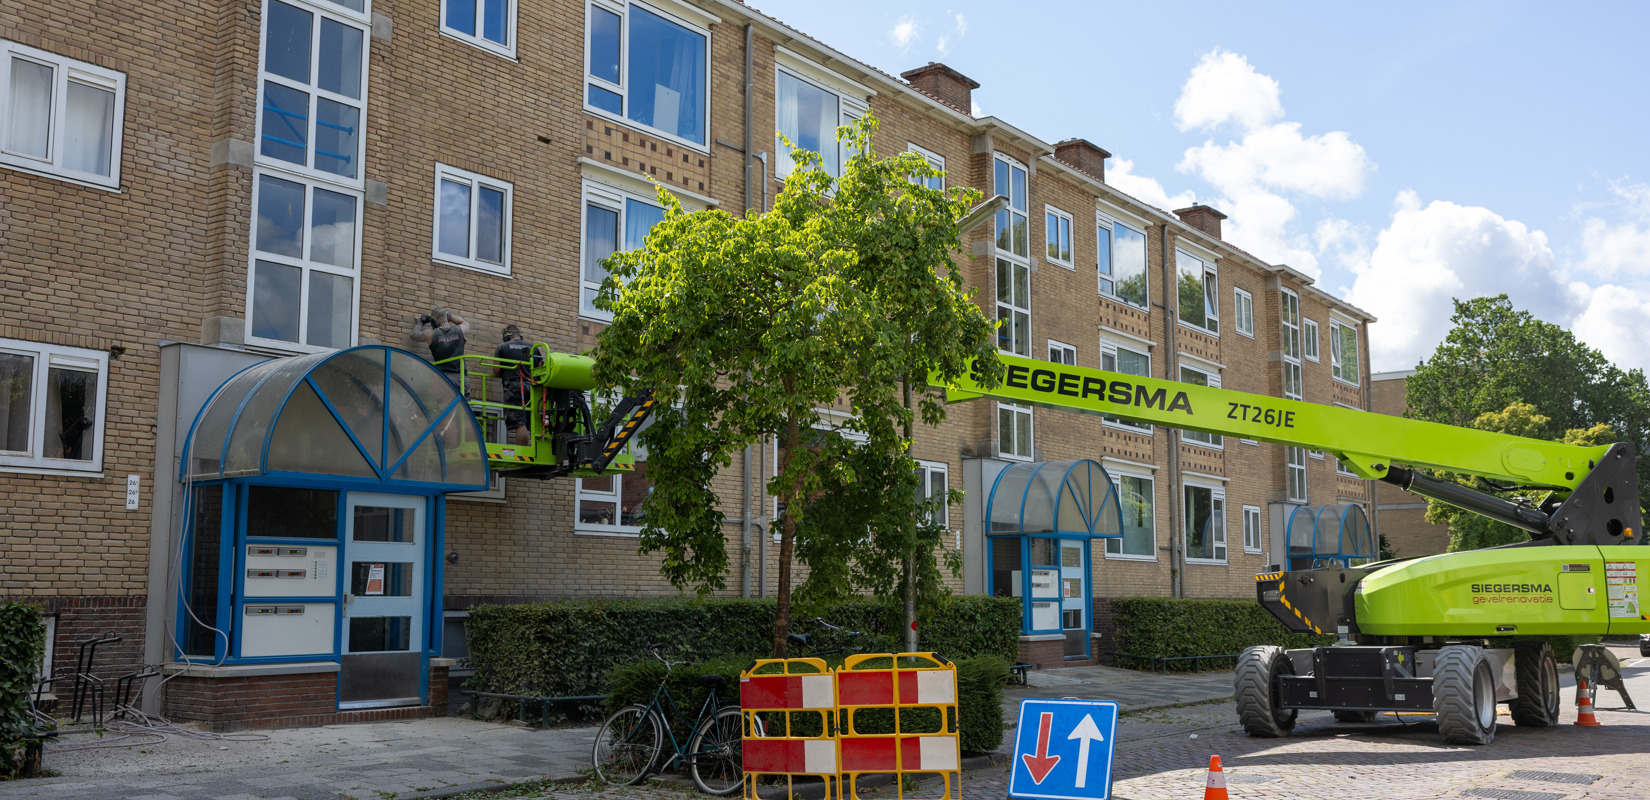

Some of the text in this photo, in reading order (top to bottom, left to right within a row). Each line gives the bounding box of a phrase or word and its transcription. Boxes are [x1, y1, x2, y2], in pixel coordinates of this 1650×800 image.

[1227, 402, 1296, 428] ZT26JE
[1471, 584, 1552, 593] SIEGERSMA
[1472, 594, 1553, 605] gevelrenovatie
